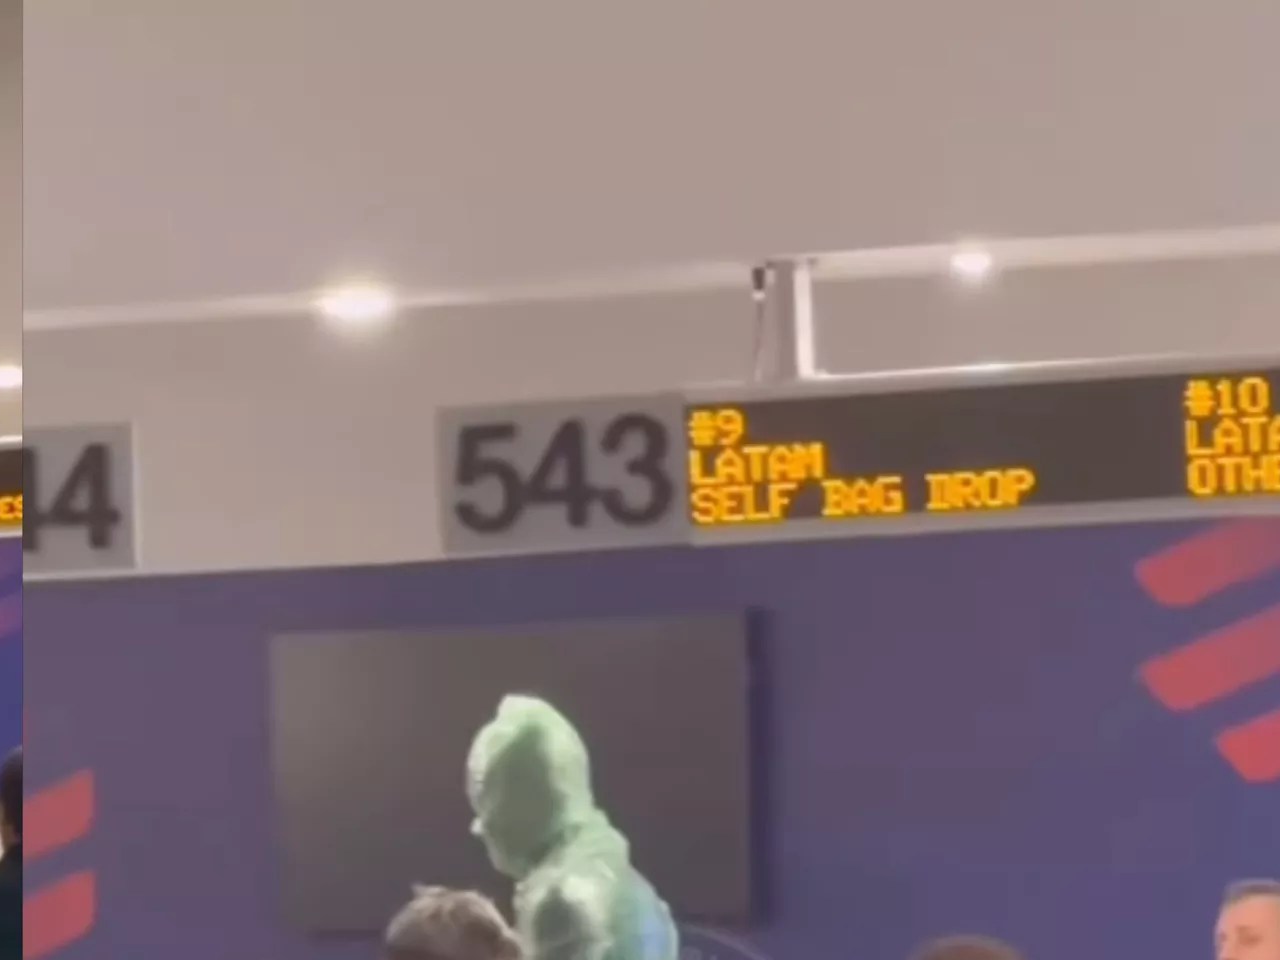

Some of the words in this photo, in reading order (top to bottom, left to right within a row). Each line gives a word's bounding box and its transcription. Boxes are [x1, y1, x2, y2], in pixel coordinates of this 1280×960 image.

[1184, 376, 1269, 416] #10
[689, 408, 744, 446] #9
[453, 412, 674, 534] 543
[690, 441, 824, 484] LATAM
[691, 483, 798, 523] SELF
[821, 476, 904, 516] BAG
[926, 470, 1036, 511] DROP
